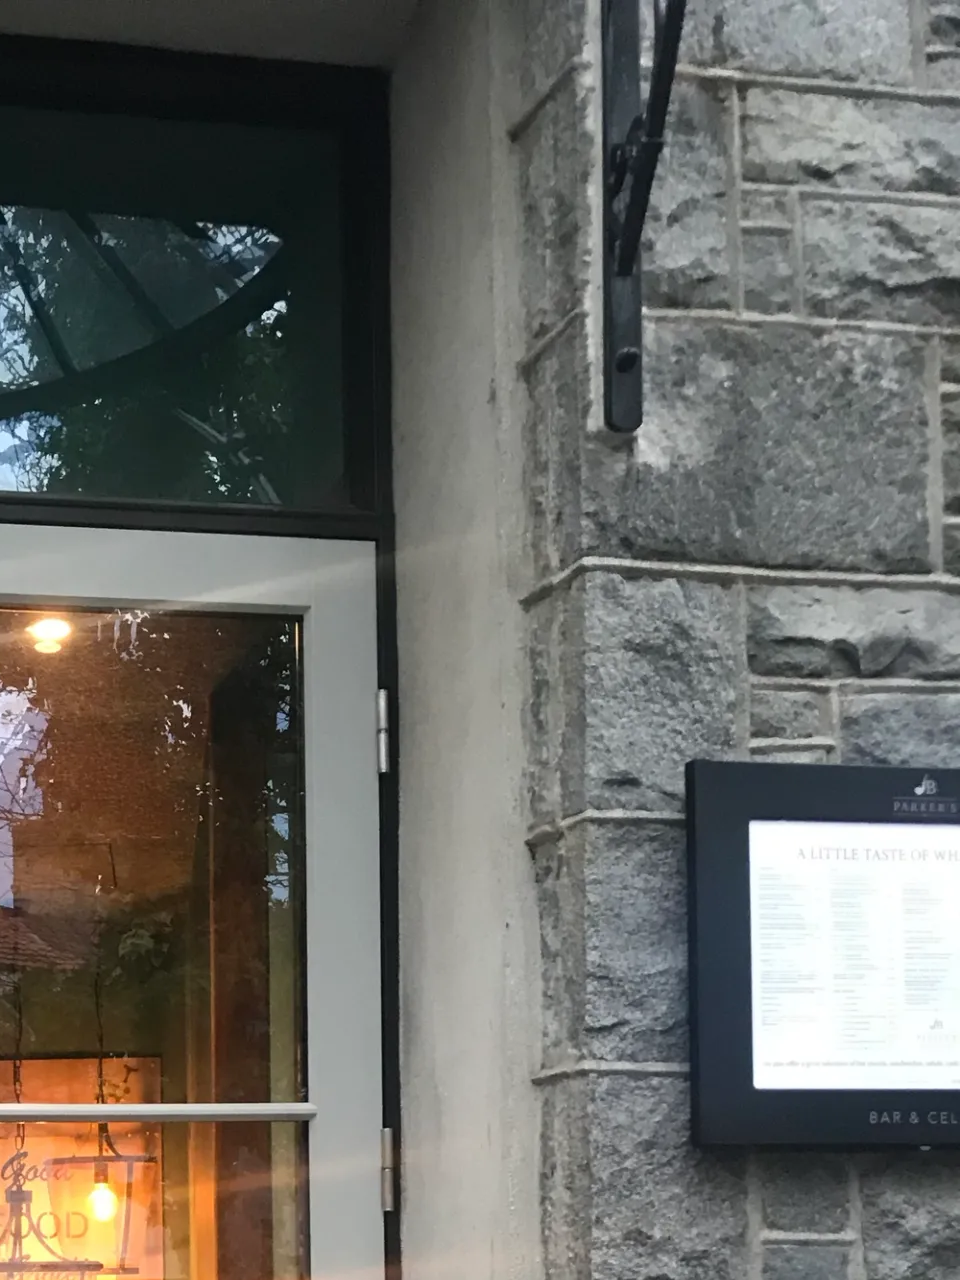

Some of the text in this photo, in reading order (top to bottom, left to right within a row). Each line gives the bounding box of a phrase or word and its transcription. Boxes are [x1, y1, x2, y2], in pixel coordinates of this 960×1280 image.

[797, 845, 960, 863] A LITTLE TASTE OF WH
[869, 1110, 958, 1124] BAR & CEL
